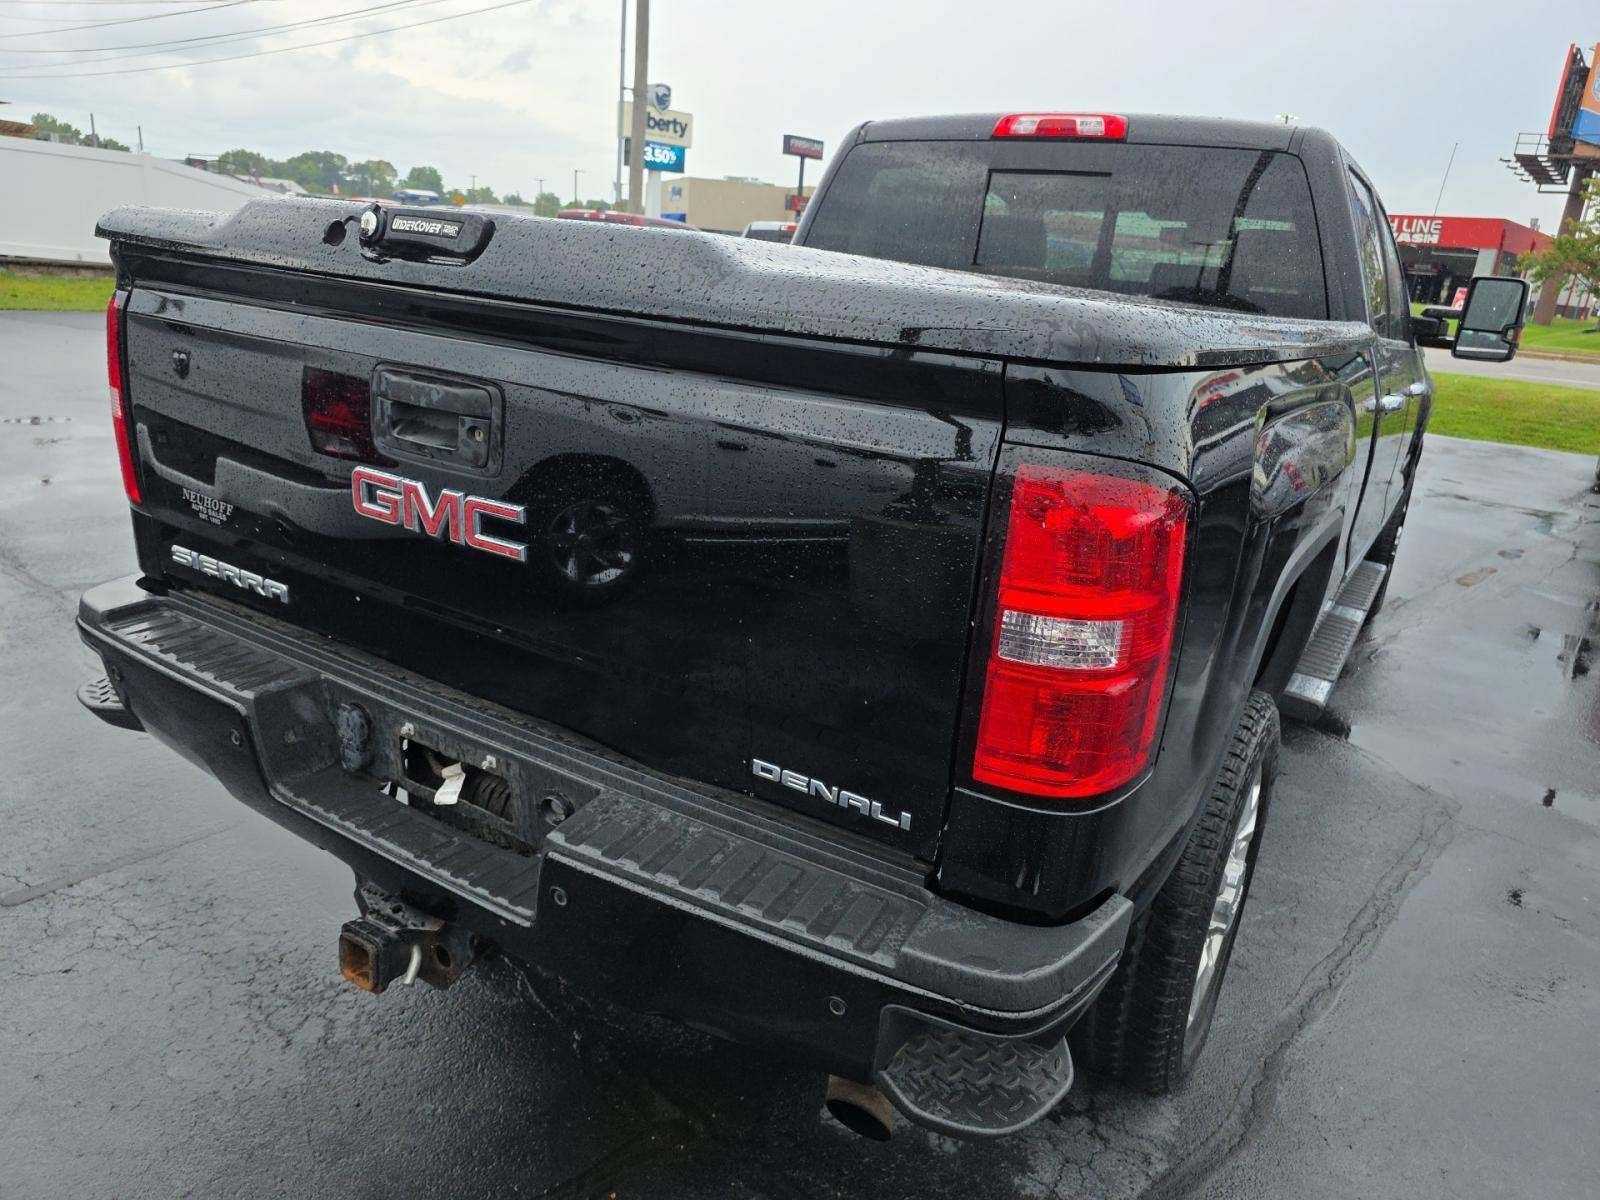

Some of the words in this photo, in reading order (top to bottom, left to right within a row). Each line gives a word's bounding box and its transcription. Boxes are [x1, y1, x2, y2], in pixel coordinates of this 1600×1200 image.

[1402, 218, 1443, 234] LINE
[182, 487, 234, 516] NEUHOFF
[352, 465, 528, 563] GMC
[171, 544, 289, 604] SIERRA
[752, 758, 912, 831] DENALI
